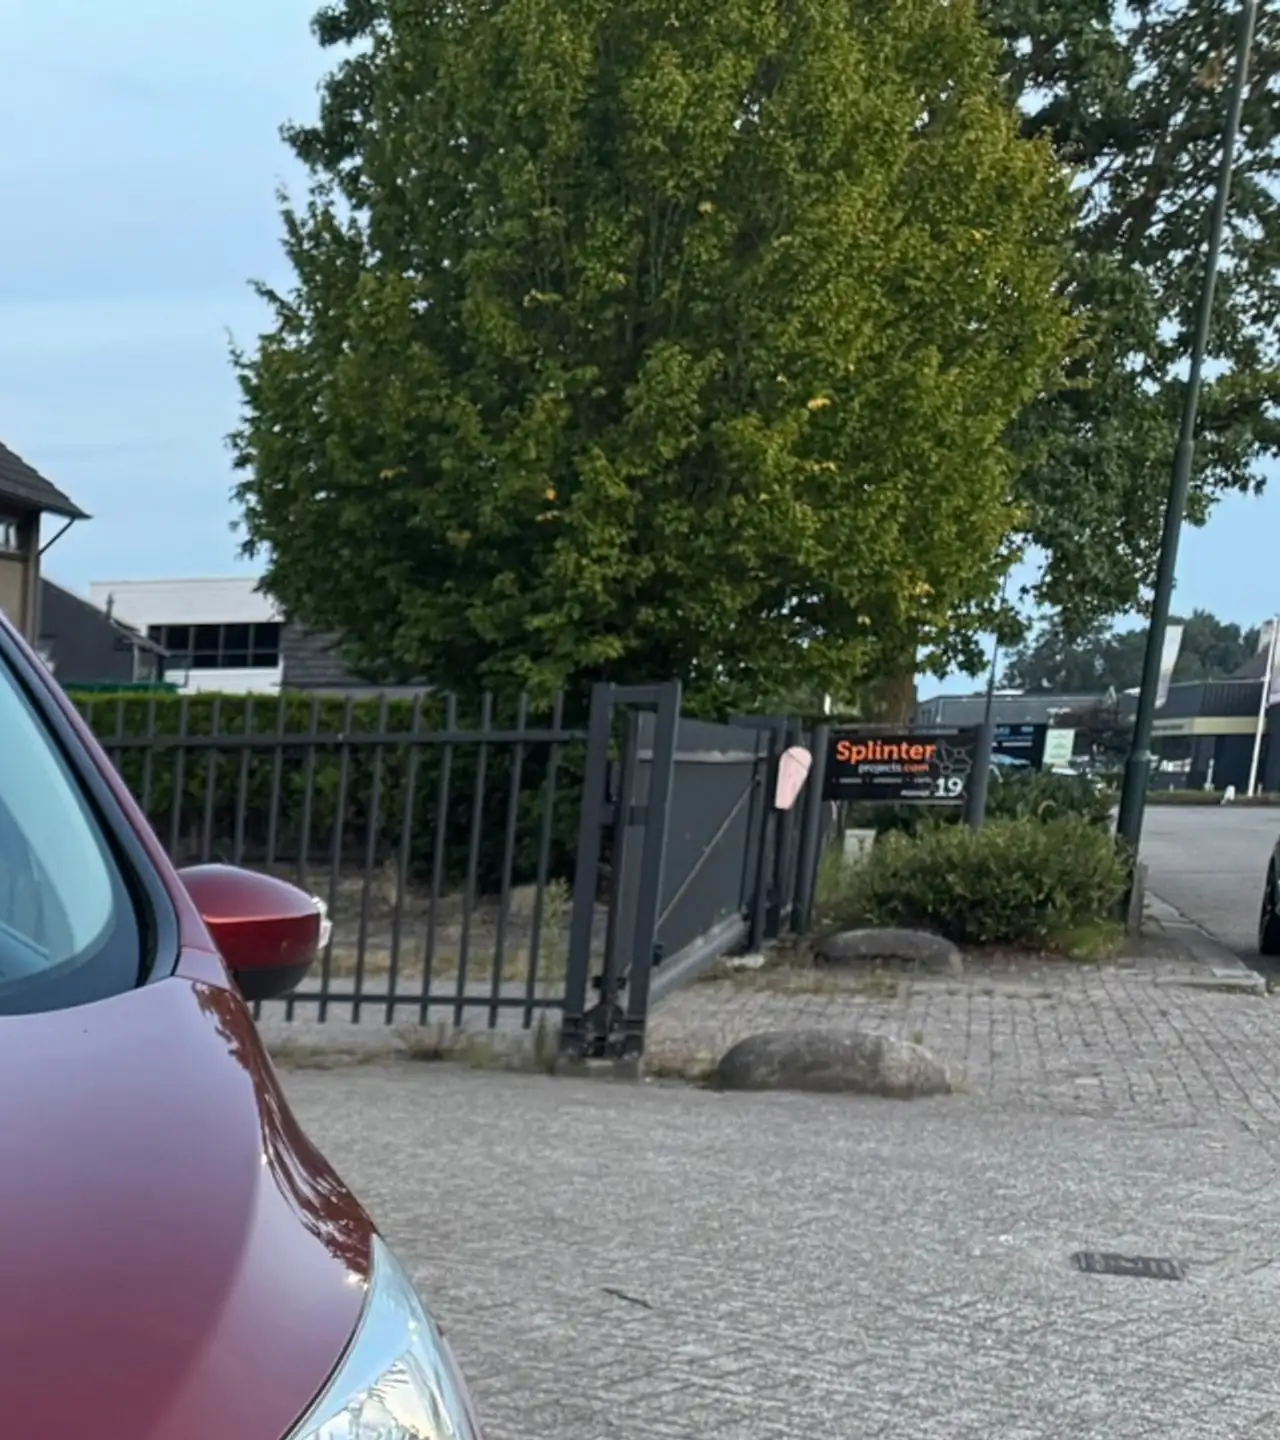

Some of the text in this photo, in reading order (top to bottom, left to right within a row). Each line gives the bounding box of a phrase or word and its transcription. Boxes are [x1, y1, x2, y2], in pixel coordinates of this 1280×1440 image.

[836, 739, 937, 765] Splinter
[858, 762, 929, 774] projects.com
[934, 777, 963, 797] 19
